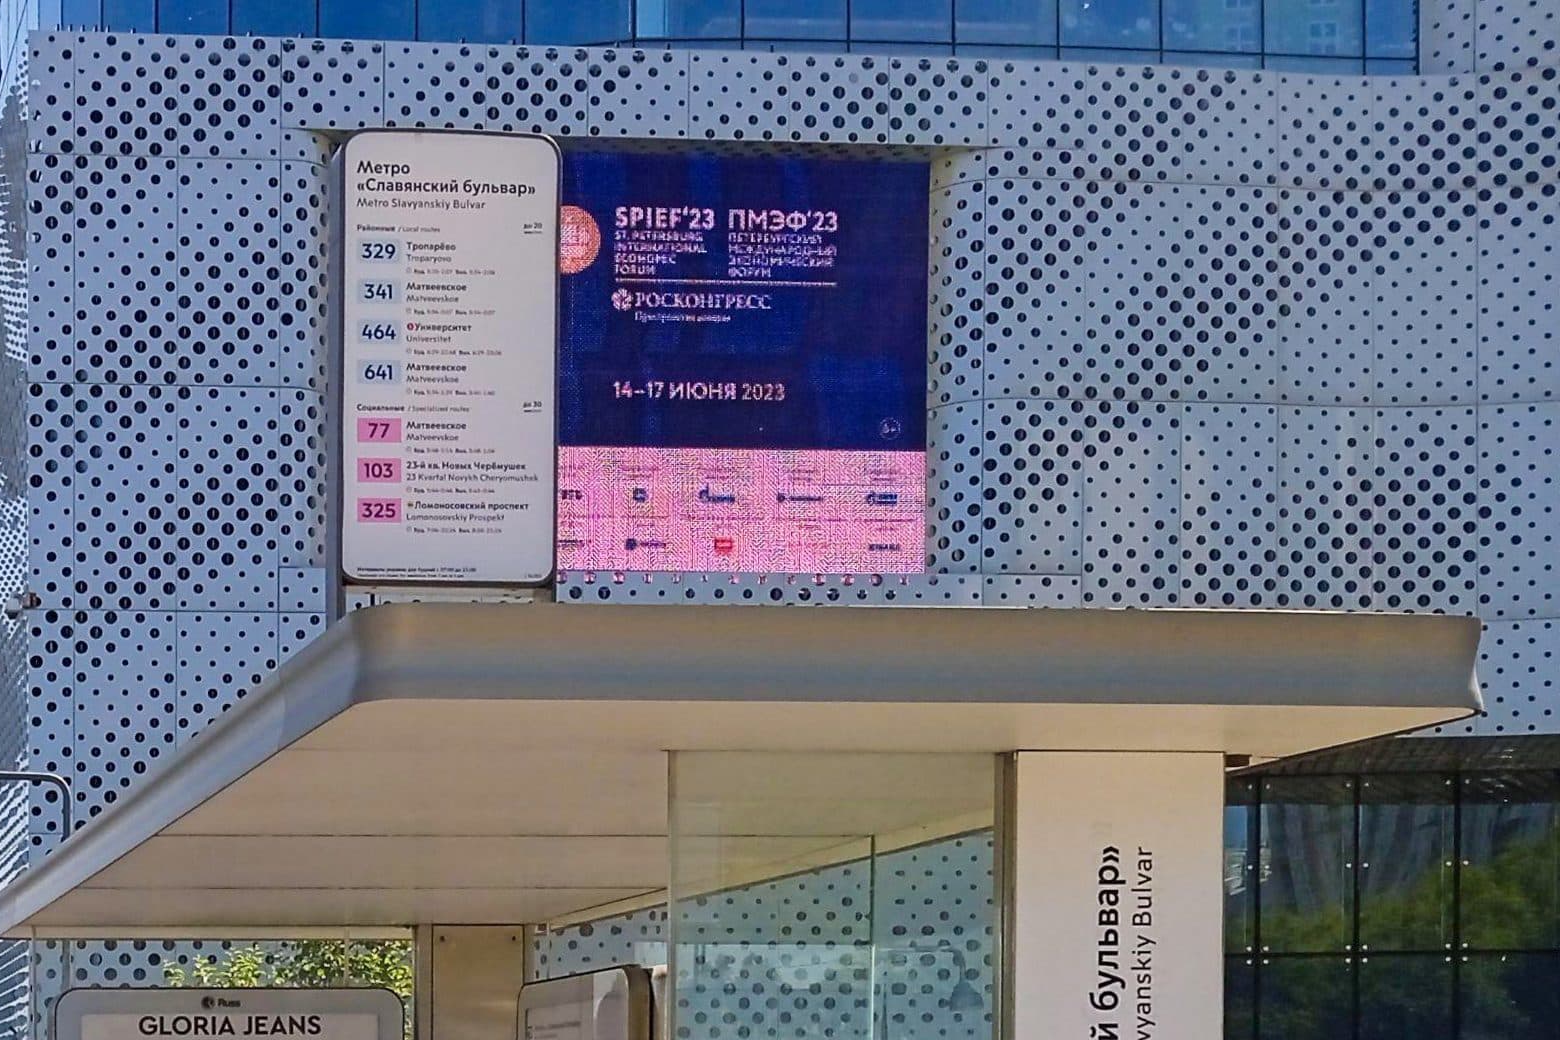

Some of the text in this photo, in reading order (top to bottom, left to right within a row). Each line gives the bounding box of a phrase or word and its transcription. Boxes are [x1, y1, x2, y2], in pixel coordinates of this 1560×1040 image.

[357, 160, 410, 177] Метро
[357, 178, 536, 198] «Славянский бульвар»
[357, 198, 486, 211] Metro Slavyanskiy Bulvar
[361, 243, 396, 259] 329
[364, 283, 393, 300] 341
[406, 282, 467, 292] Матвеевское
[634, 293, 773, 310] РОСКОНГРЕСС
[362, 324, 396, 340] 464
[415, 323, 472, 333] Университет
[364, 364, 393, 380] 641
[406, 363, 467, 372] Матвеевское
[669, 382, 737, 400] ИЮНЯ
[741, 383, 786, 400] 2023
[368, 423, 390, 439] 77
[406, 421, 467, 430] Матвеевское
[364, 463, 394, 479] 103
[362, 503, 396, 519] 325
[414, 501, 529, 512] Ломоносовский проспект
[1131, 846, 1153, 926] Bulvar
[1089, 846, 1127, 1011] бульвар»
[139, 1016, 322, 1036] GLORIA JEANS
